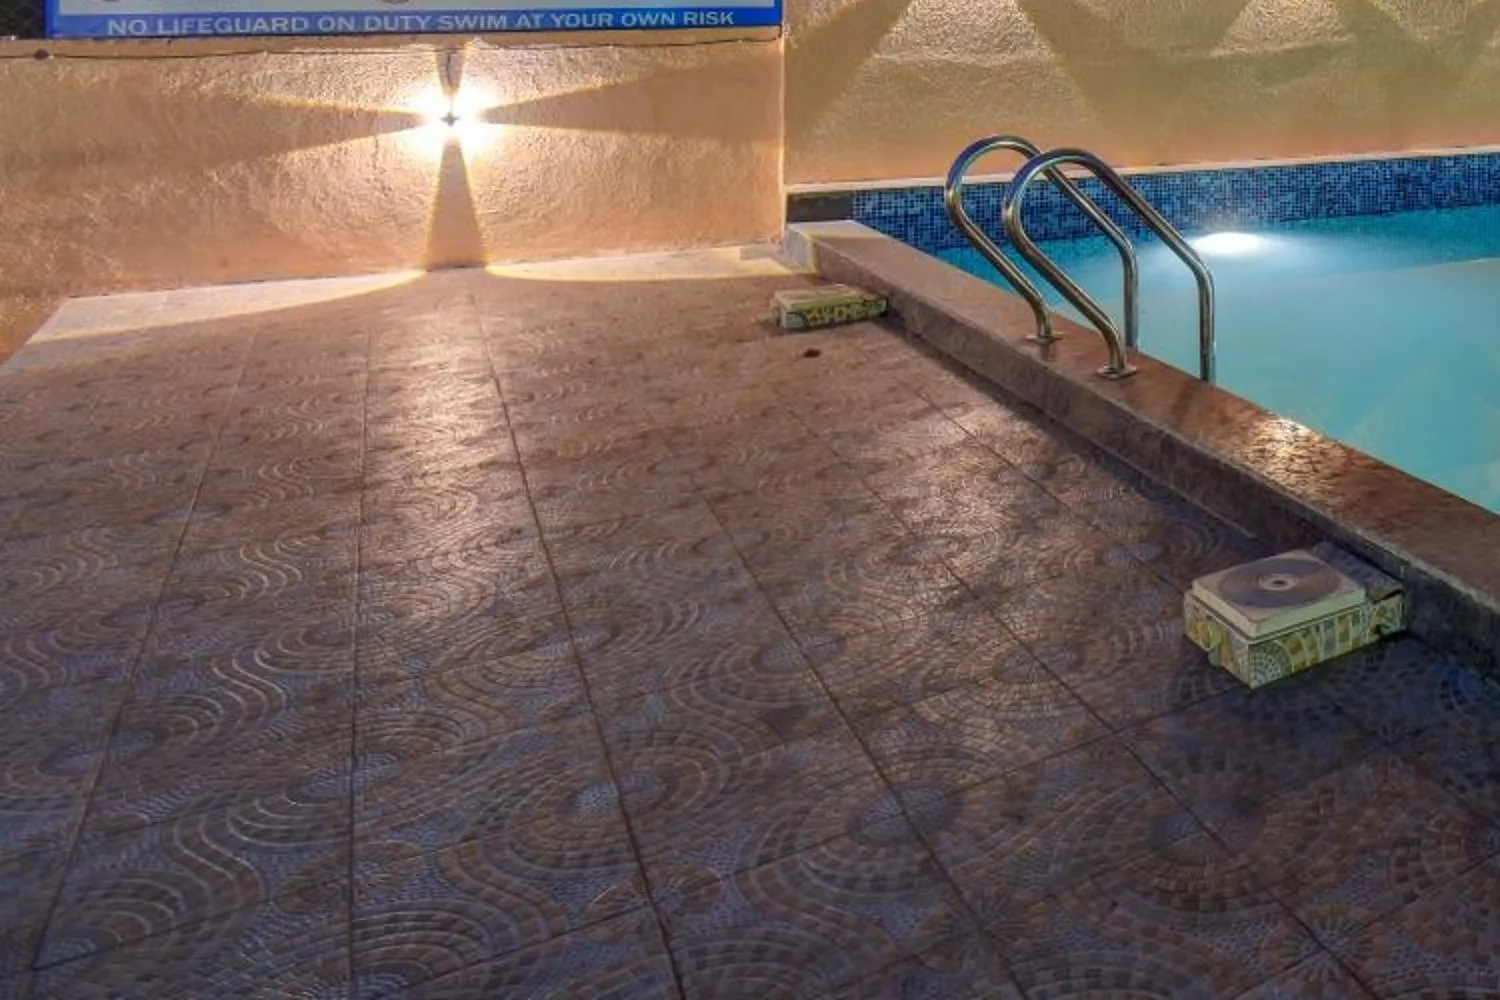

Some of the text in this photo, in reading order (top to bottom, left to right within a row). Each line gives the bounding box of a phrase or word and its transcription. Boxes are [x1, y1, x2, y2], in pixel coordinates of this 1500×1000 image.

[107, 10, 735, 36] NO LIFEGUARD ON DUTY SWIM AT YOUR OWN RISK
